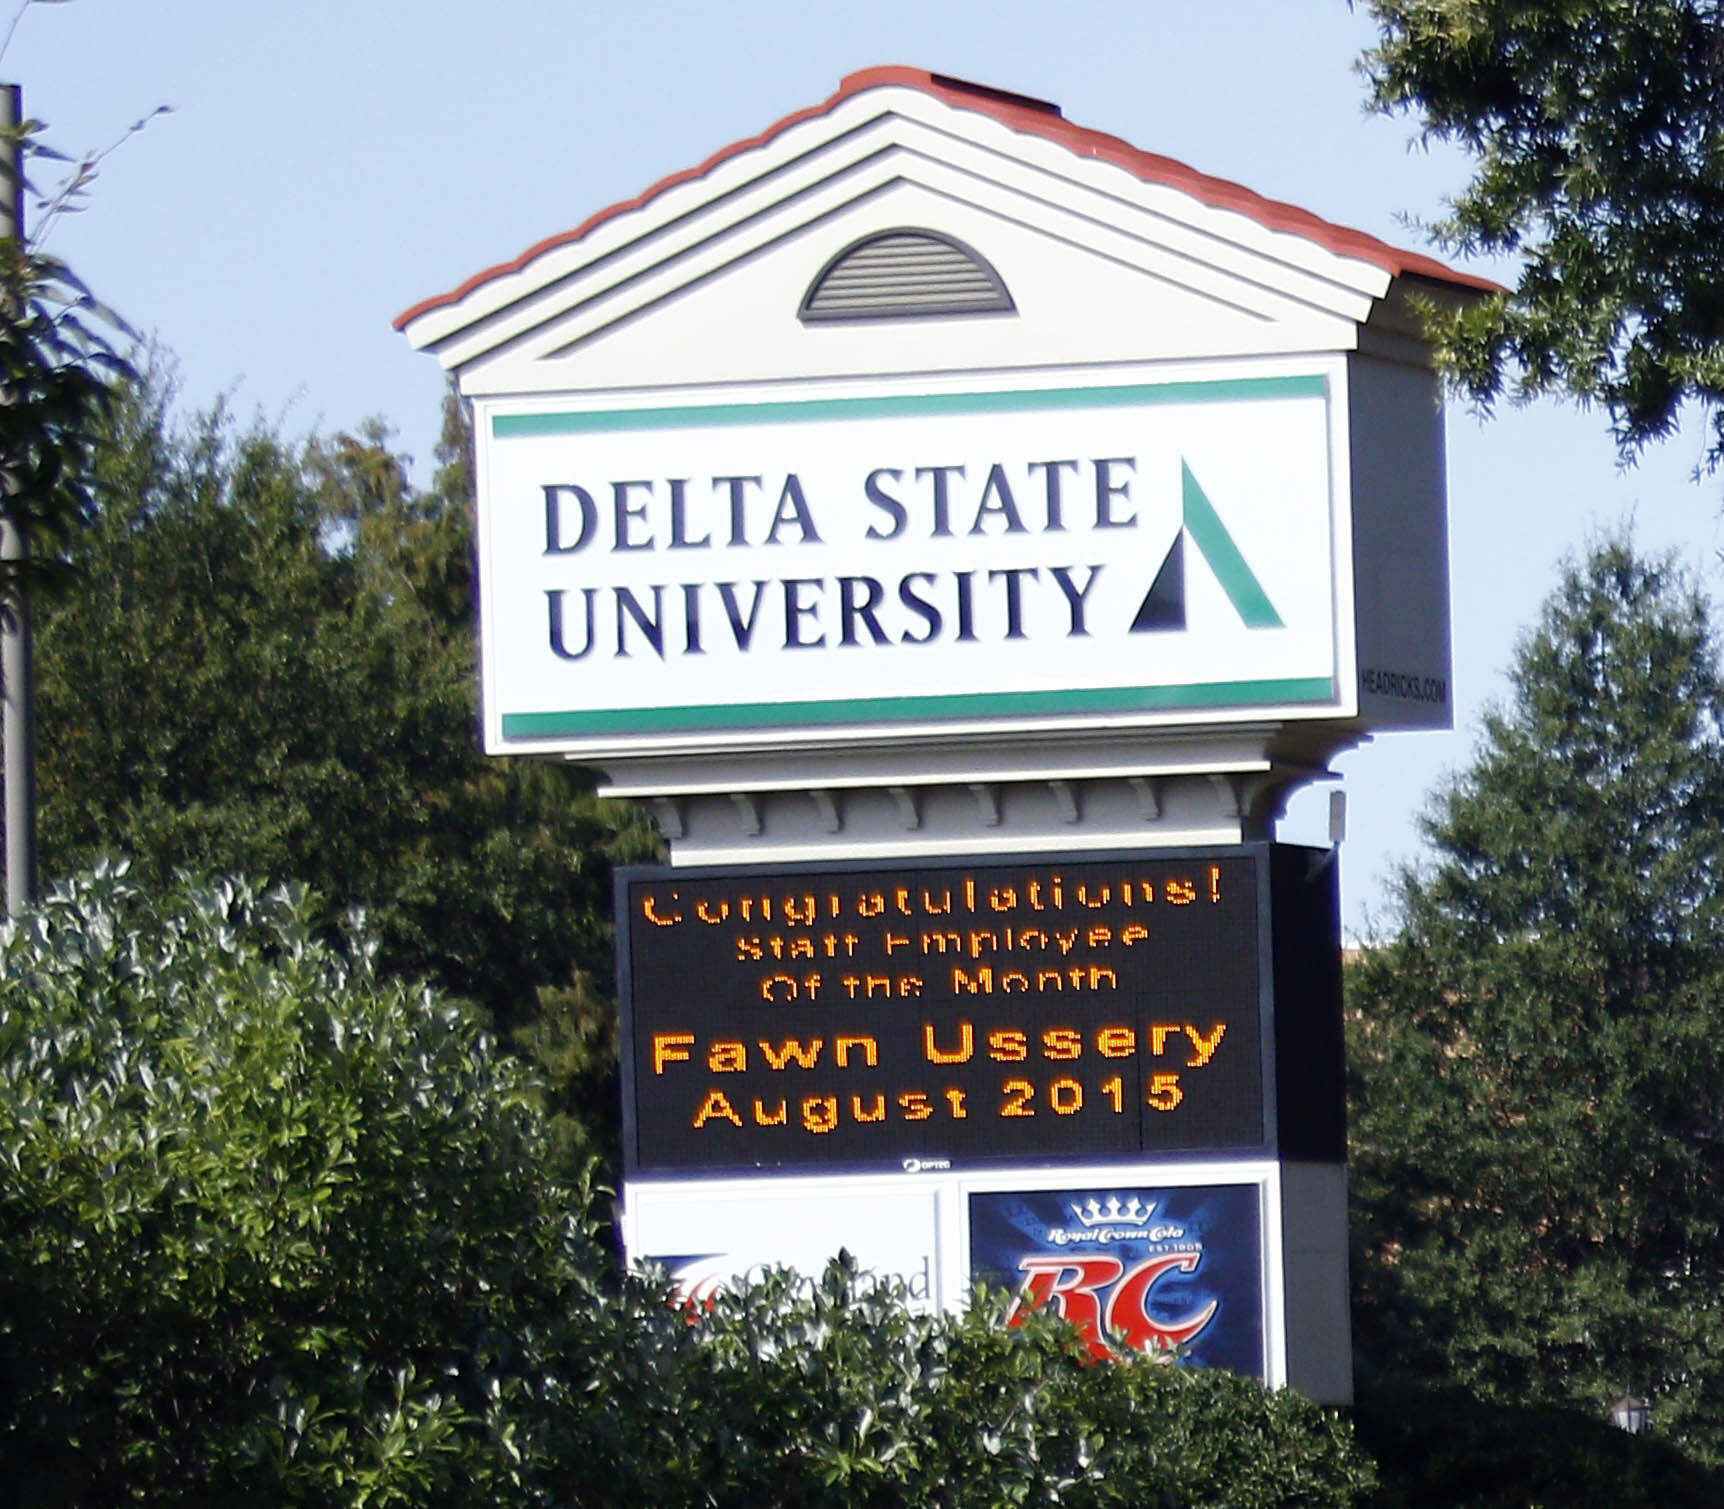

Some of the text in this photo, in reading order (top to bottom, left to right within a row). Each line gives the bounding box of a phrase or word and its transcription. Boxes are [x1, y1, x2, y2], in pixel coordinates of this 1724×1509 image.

[541, 456, 1140, 556] DELTA STATE
[543, 564, 1106, 662] UNIVERSITY
[1361, 668, 1447, 703] HEADRICKS.COM
[642, 867, 1222, 928] Congratulations!
[884, 924, 1151, 958] Employee
[760, 966, 1120, 1003] Of the Month
[652, 1022, 1227, 1076] Fawn Ussery
[693, 1074, 1187, 1135] August 2015
[1048, 1225, 1185, 1244] Royal Crown Cola
[1003, 1252, 1218, 1368] RC
